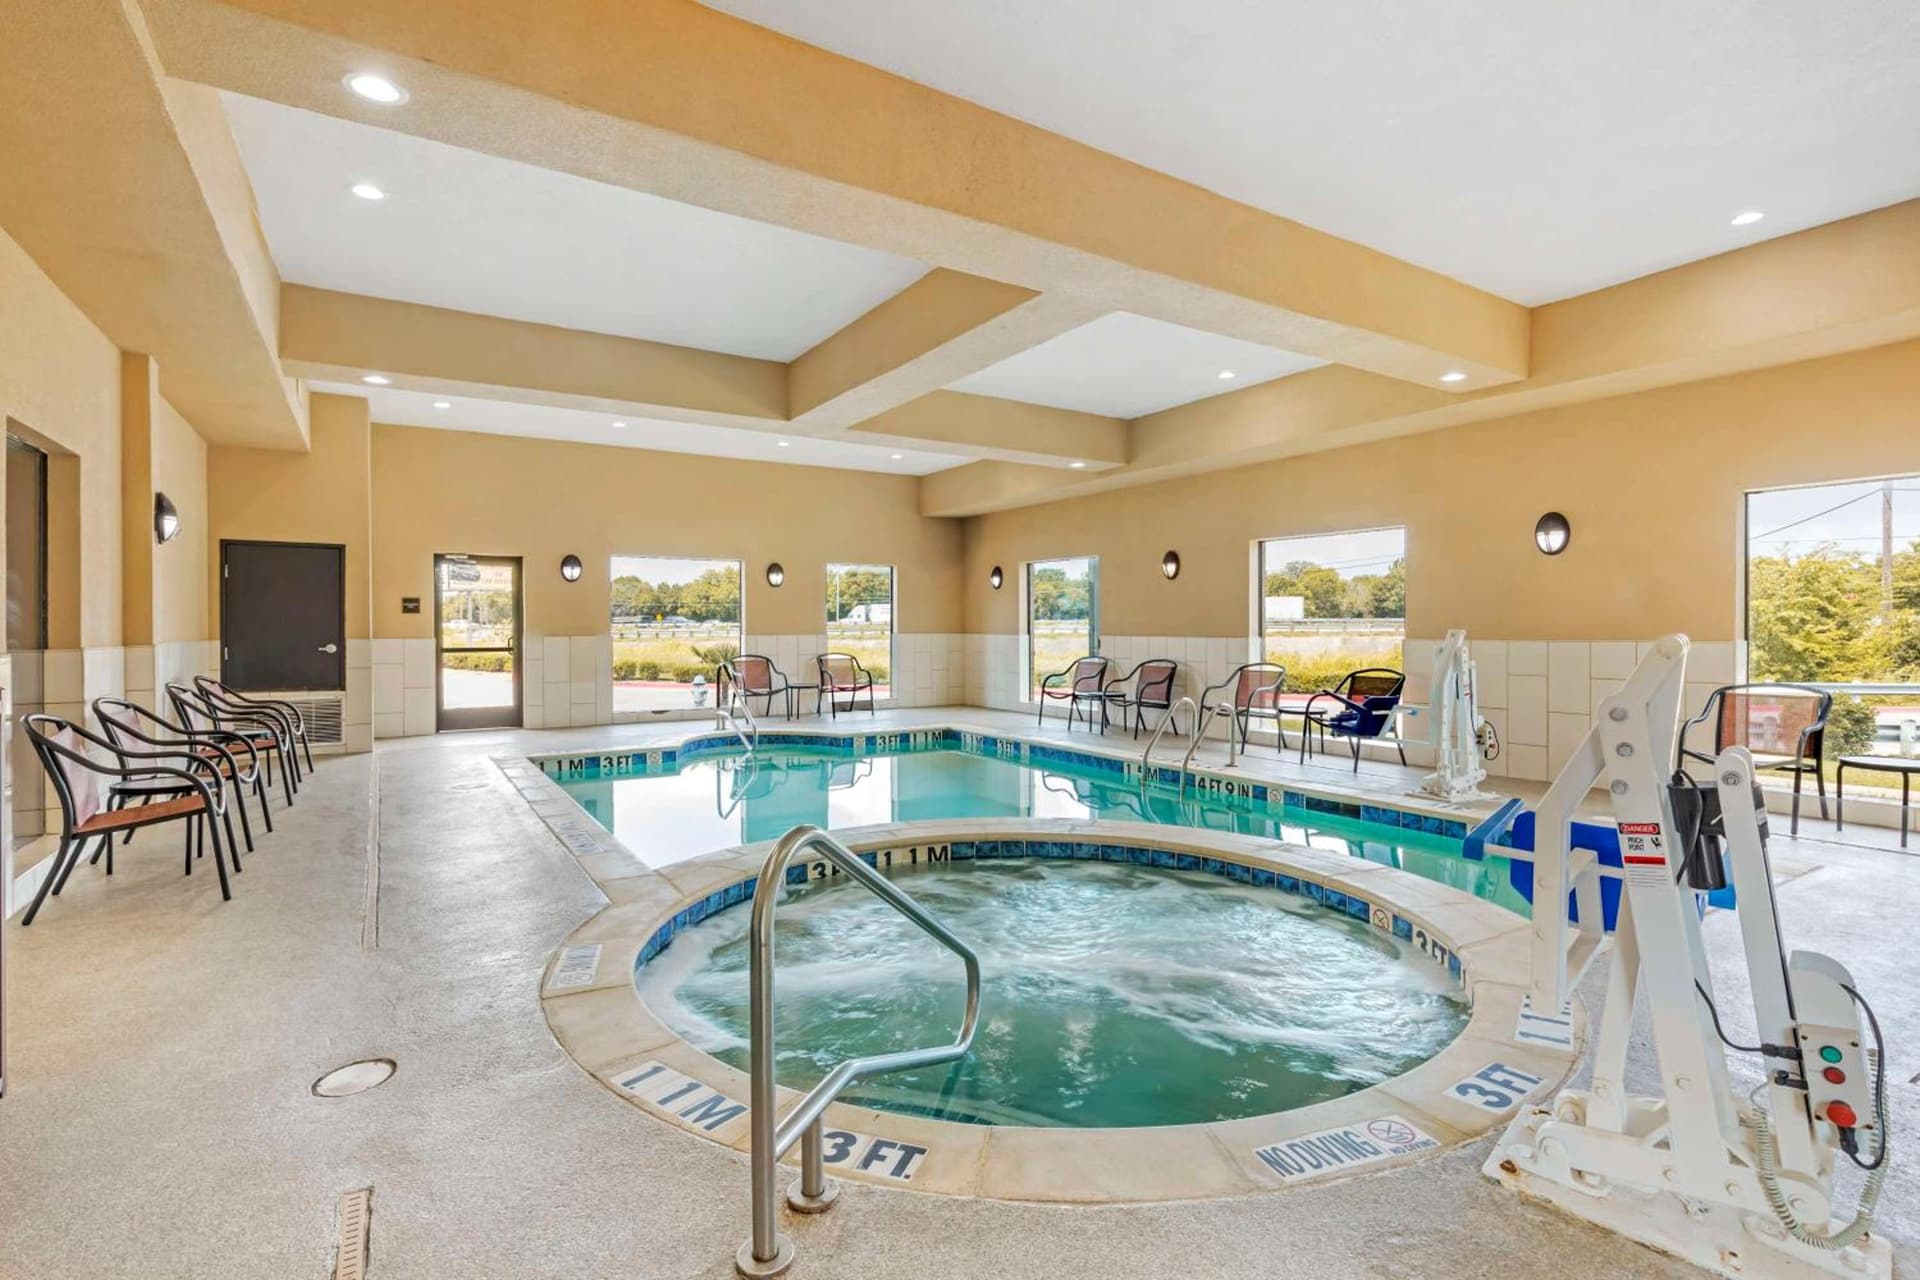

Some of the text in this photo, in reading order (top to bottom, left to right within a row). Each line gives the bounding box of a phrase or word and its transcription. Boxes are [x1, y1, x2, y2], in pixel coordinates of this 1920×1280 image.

[603, 755, 631, 768] 3 FT
[1198, 777, 1249, 797] 4 FT 9 IN
[1622, 824, 1654, 832] DANGER
[812, 862, 827, 879] 3
[1455, 1082, 1513, 1109] 3
[823, 1130, 857, 1163] 3
[1256, 1129, 1384, 1178] NO DIVING
